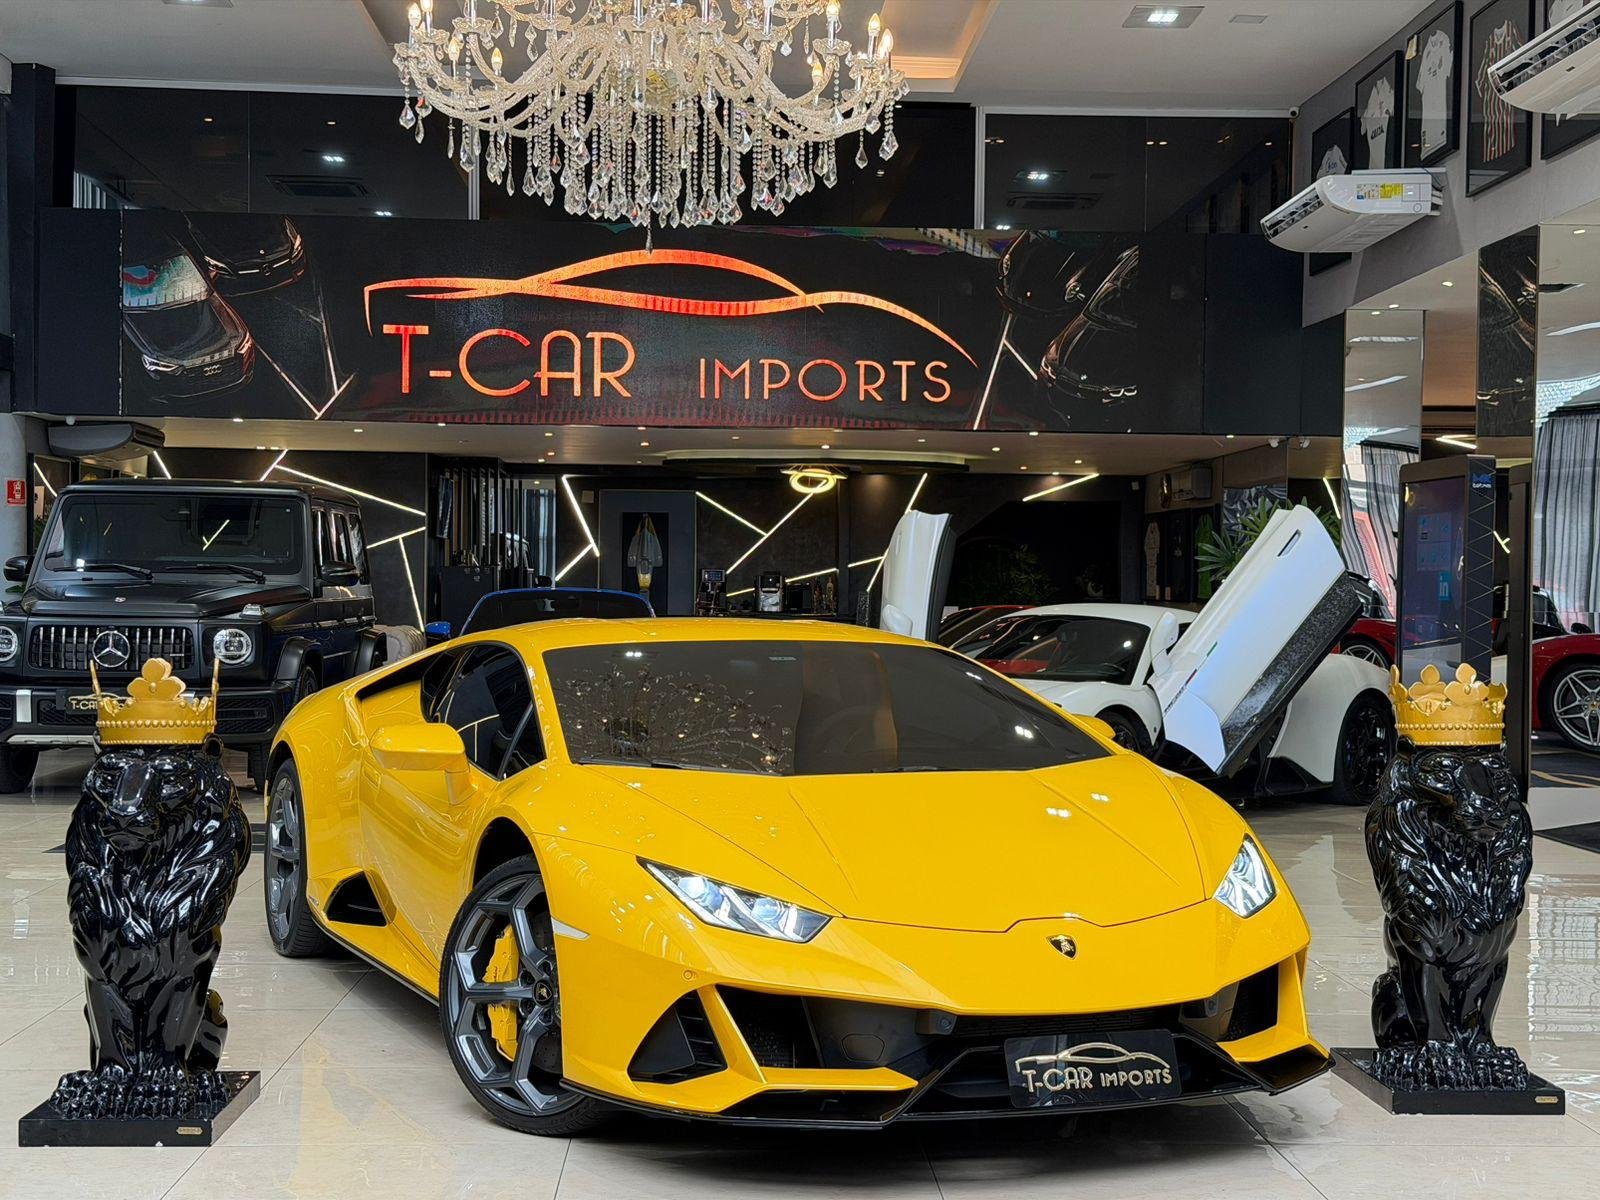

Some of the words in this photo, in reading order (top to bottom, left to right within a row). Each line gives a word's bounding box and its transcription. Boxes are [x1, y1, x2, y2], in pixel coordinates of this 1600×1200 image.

[383, 323, 636, 398] T-CAR
[699, 358, 952, 403] IMPORTS
[1021, 1066, 1094, 1093] T-CAR
[1099, 1068, 1173, 1088] IMPORTS
